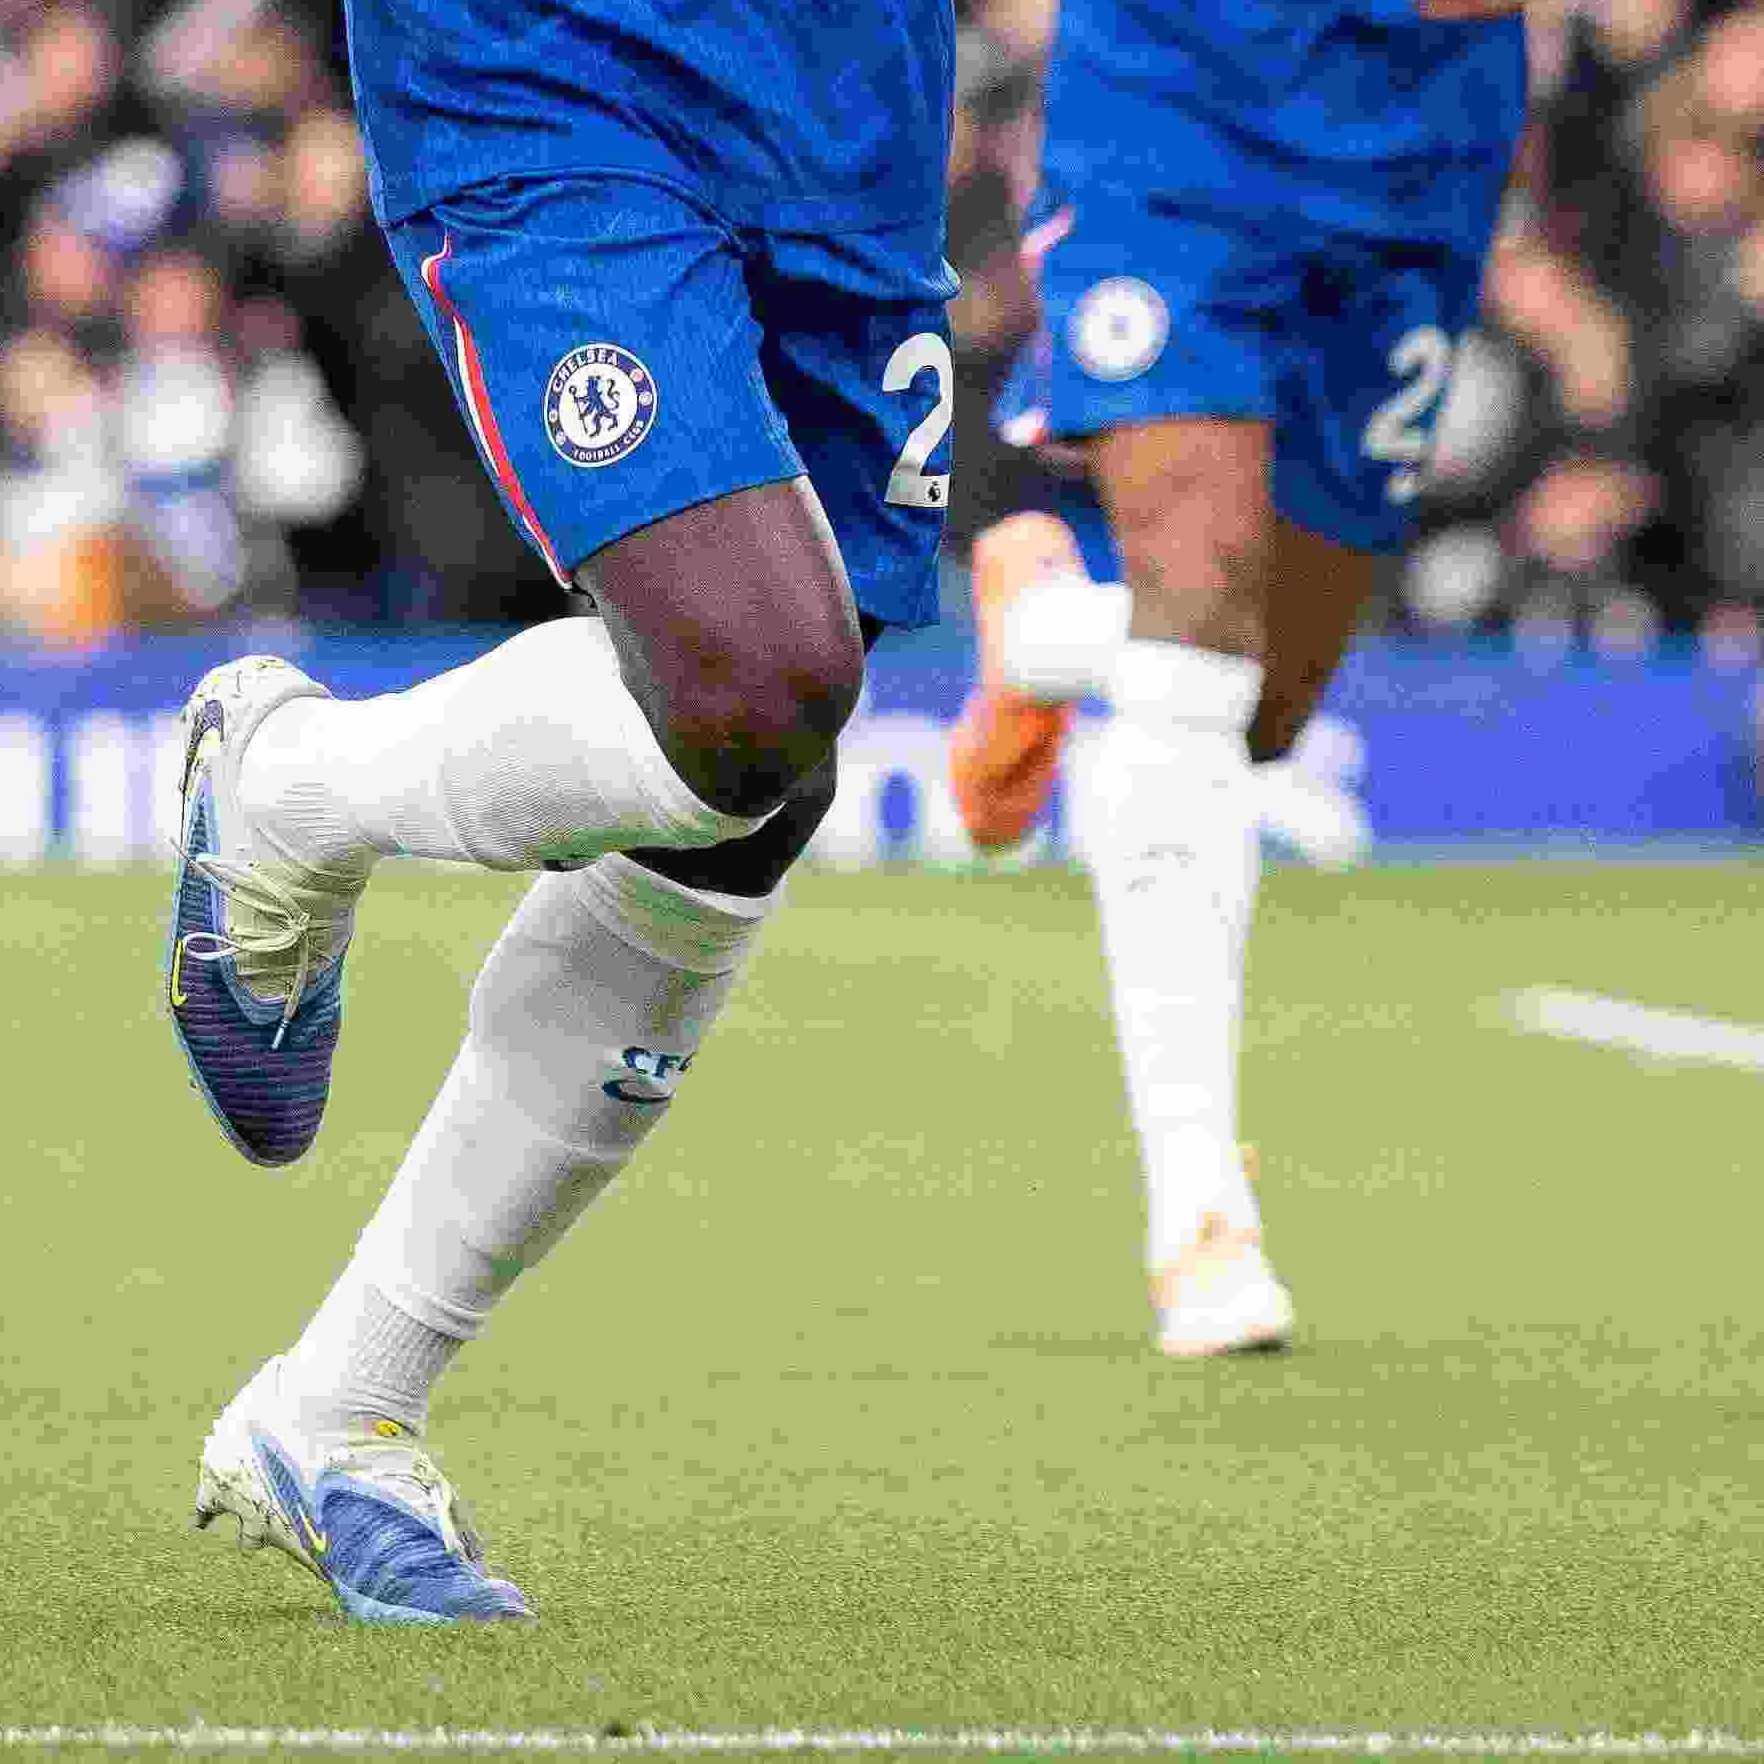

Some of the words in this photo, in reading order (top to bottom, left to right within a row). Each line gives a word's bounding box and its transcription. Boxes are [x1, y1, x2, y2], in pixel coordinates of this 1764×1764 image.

[553, 348, 620, 392] CHELSEA
[882, 332, 953, 508] 2
[572, 444, 621, 461] FOOTBALL
